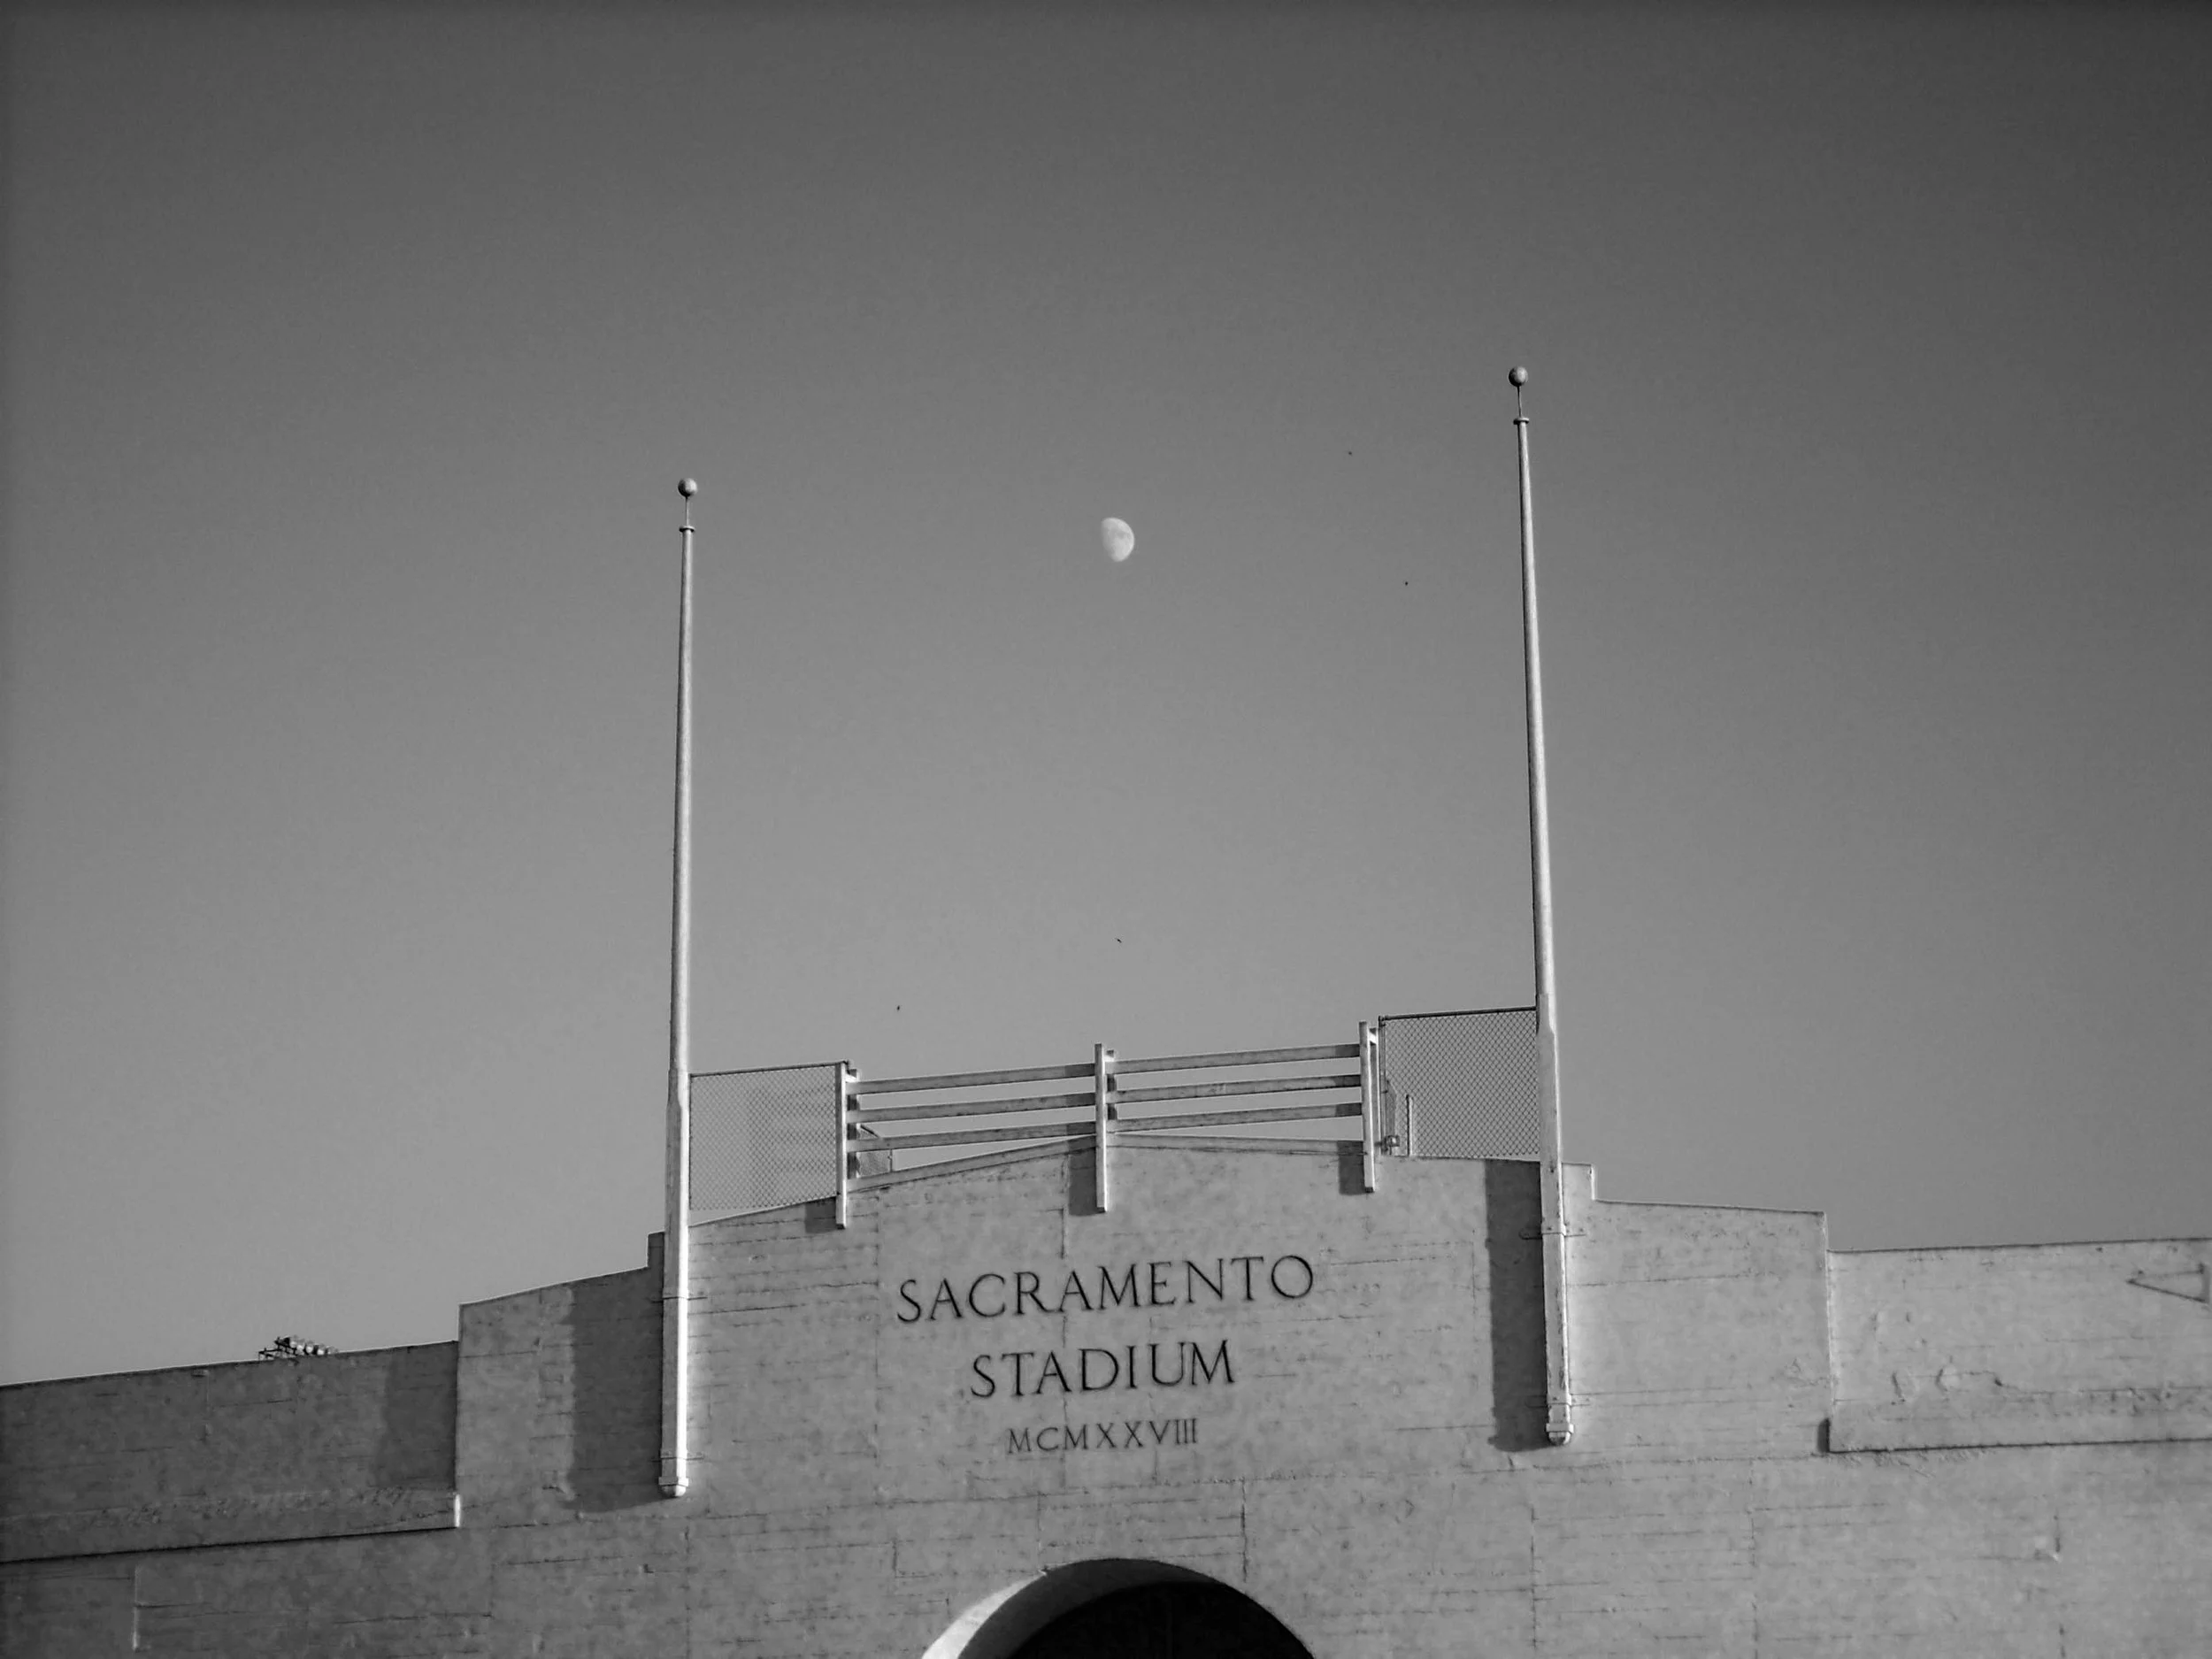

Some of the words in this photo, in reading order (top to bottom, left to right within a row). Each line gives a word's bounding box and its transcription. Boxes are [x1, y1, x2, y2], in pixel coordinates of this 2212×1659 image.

[896, 1255, 1314, 1323] SACRAMENTO
[970, 1339, 1235, 1399] STADIUM
[1007, 1417, 1198, 1455] MCMXXVIII
